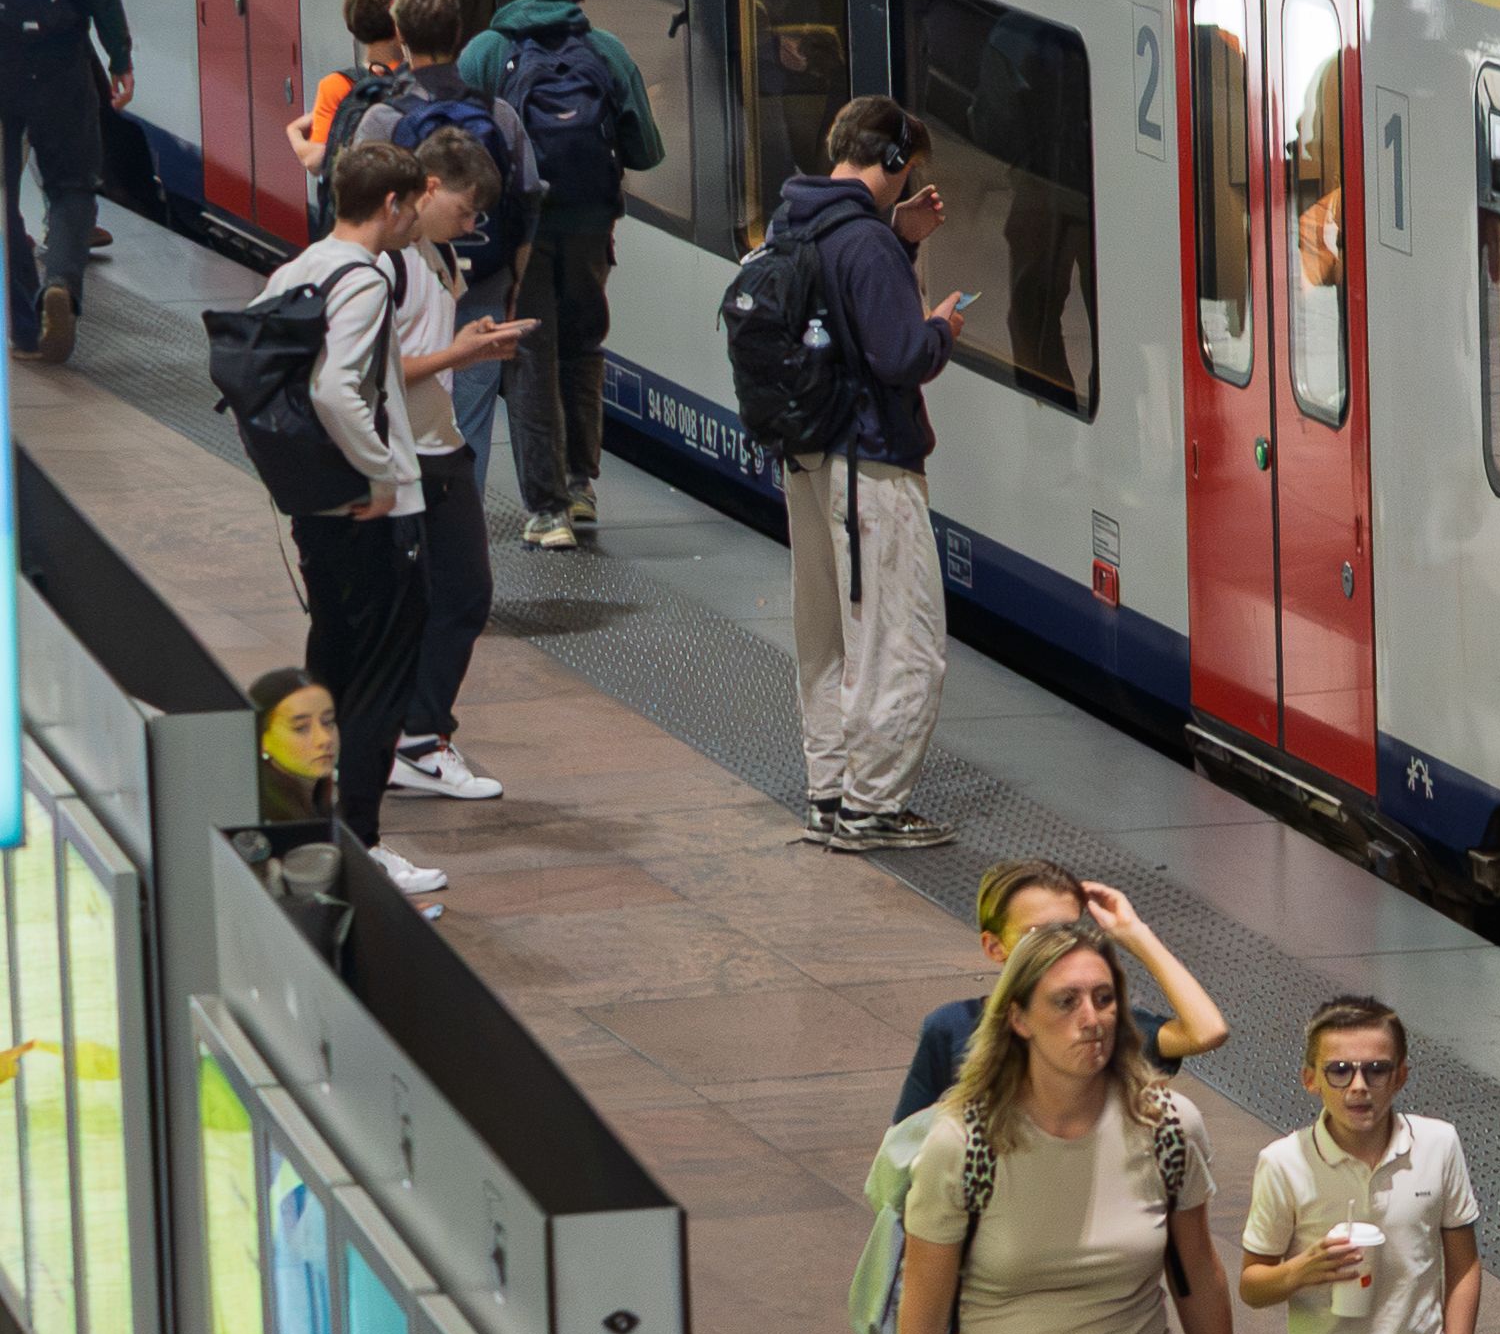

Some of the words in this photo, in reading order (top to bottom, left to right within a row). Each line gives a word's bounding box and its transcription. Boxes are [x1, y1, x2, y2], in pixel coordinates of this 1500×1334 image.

[1136, 25, 1163, 142] 2
[1384, 112, 1403, 231] 1
[648, 388, 661, 422] 94
[663, 395, 676, 430] 88
[678, 403, 697, 441] 008
[700, 413, 718, 450] 147
[721, 425, 737, 460] 1-7
